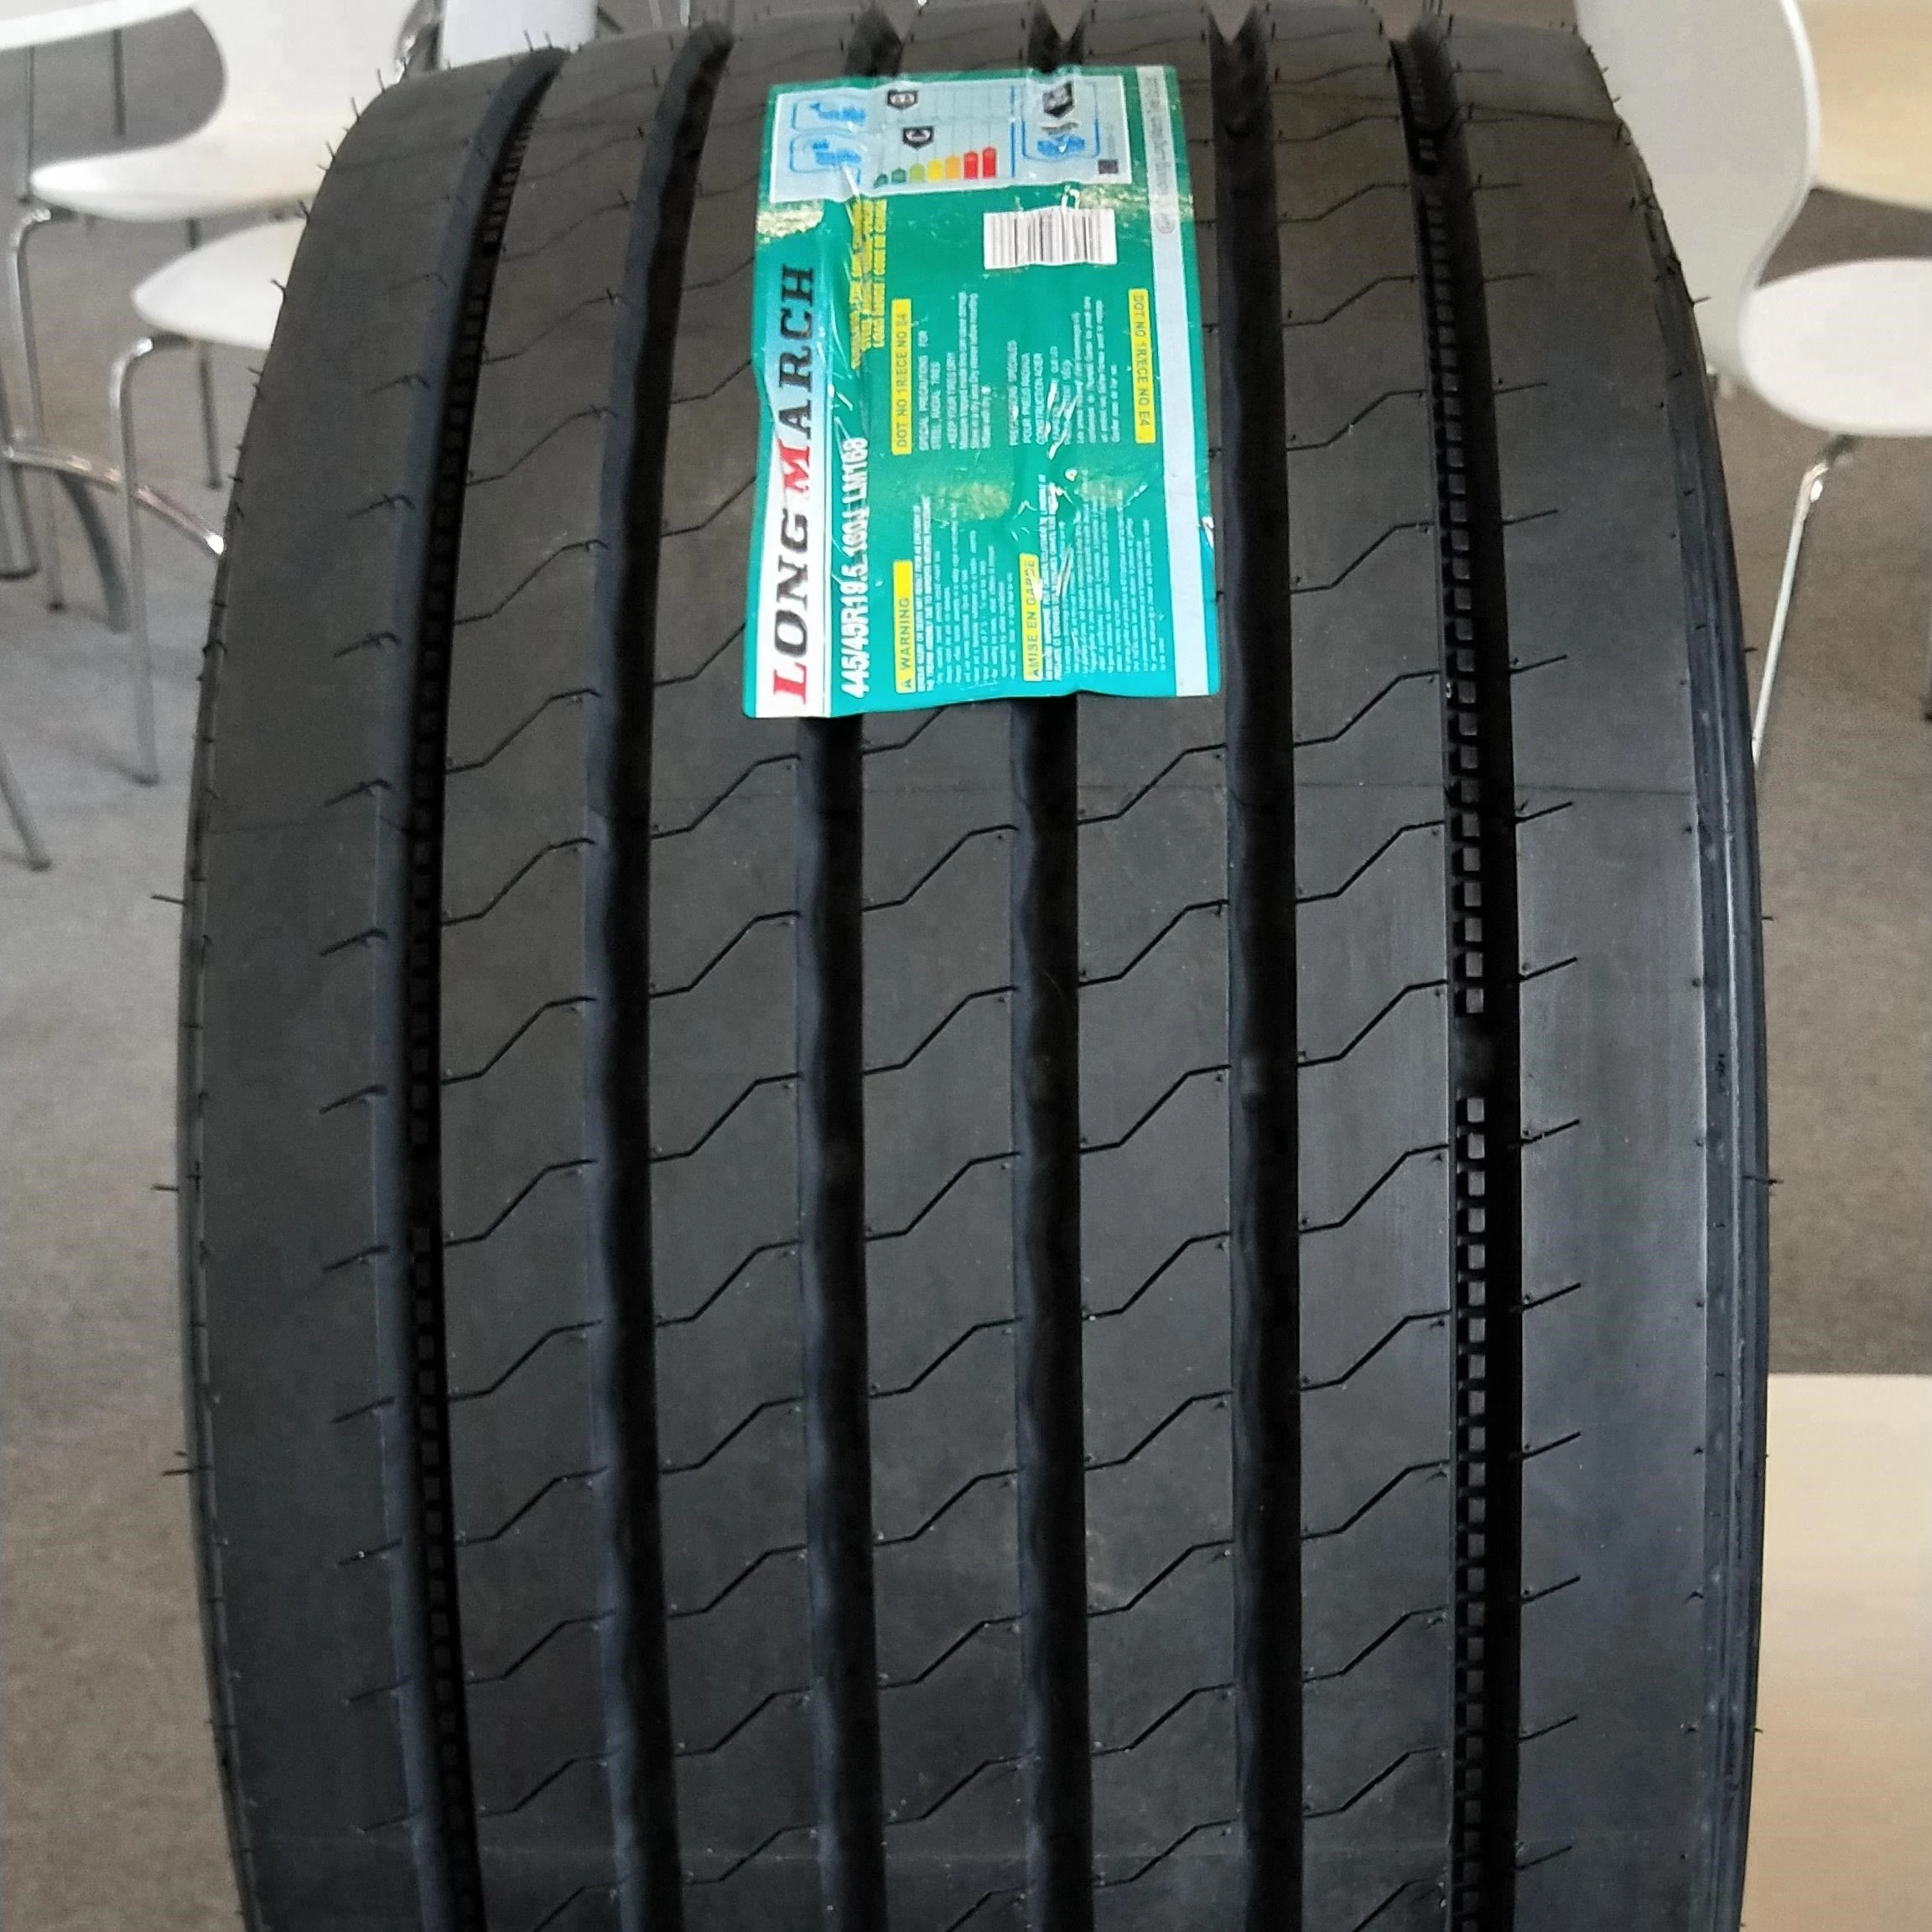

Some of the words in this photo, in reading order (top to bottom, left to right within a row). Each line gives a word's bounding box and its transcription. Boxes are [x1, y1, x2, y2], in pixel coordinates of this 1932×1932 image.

[906, 129, 931, 142] C
[1134, 295, 1144, 319] DOT
[896, 330, 907, 347] NO
[1135, 321, 1145, 337] NO
[776, 263, 813, 495] MARCH
[1137, 387, 1149, 406] NO
[896, 399, 907, 417] NO
[1139, 411, 1150, 426] E4
[896, 422, 907, 448] DOT
[772, 508, 808, 705] LONG
[1026, 610, 1037, 629] EN
[840, 564, 870, 698] 445/45R19.5
[897, 597, 912, 670] WARNING
[1026, 634, 1038, 667] MISE
